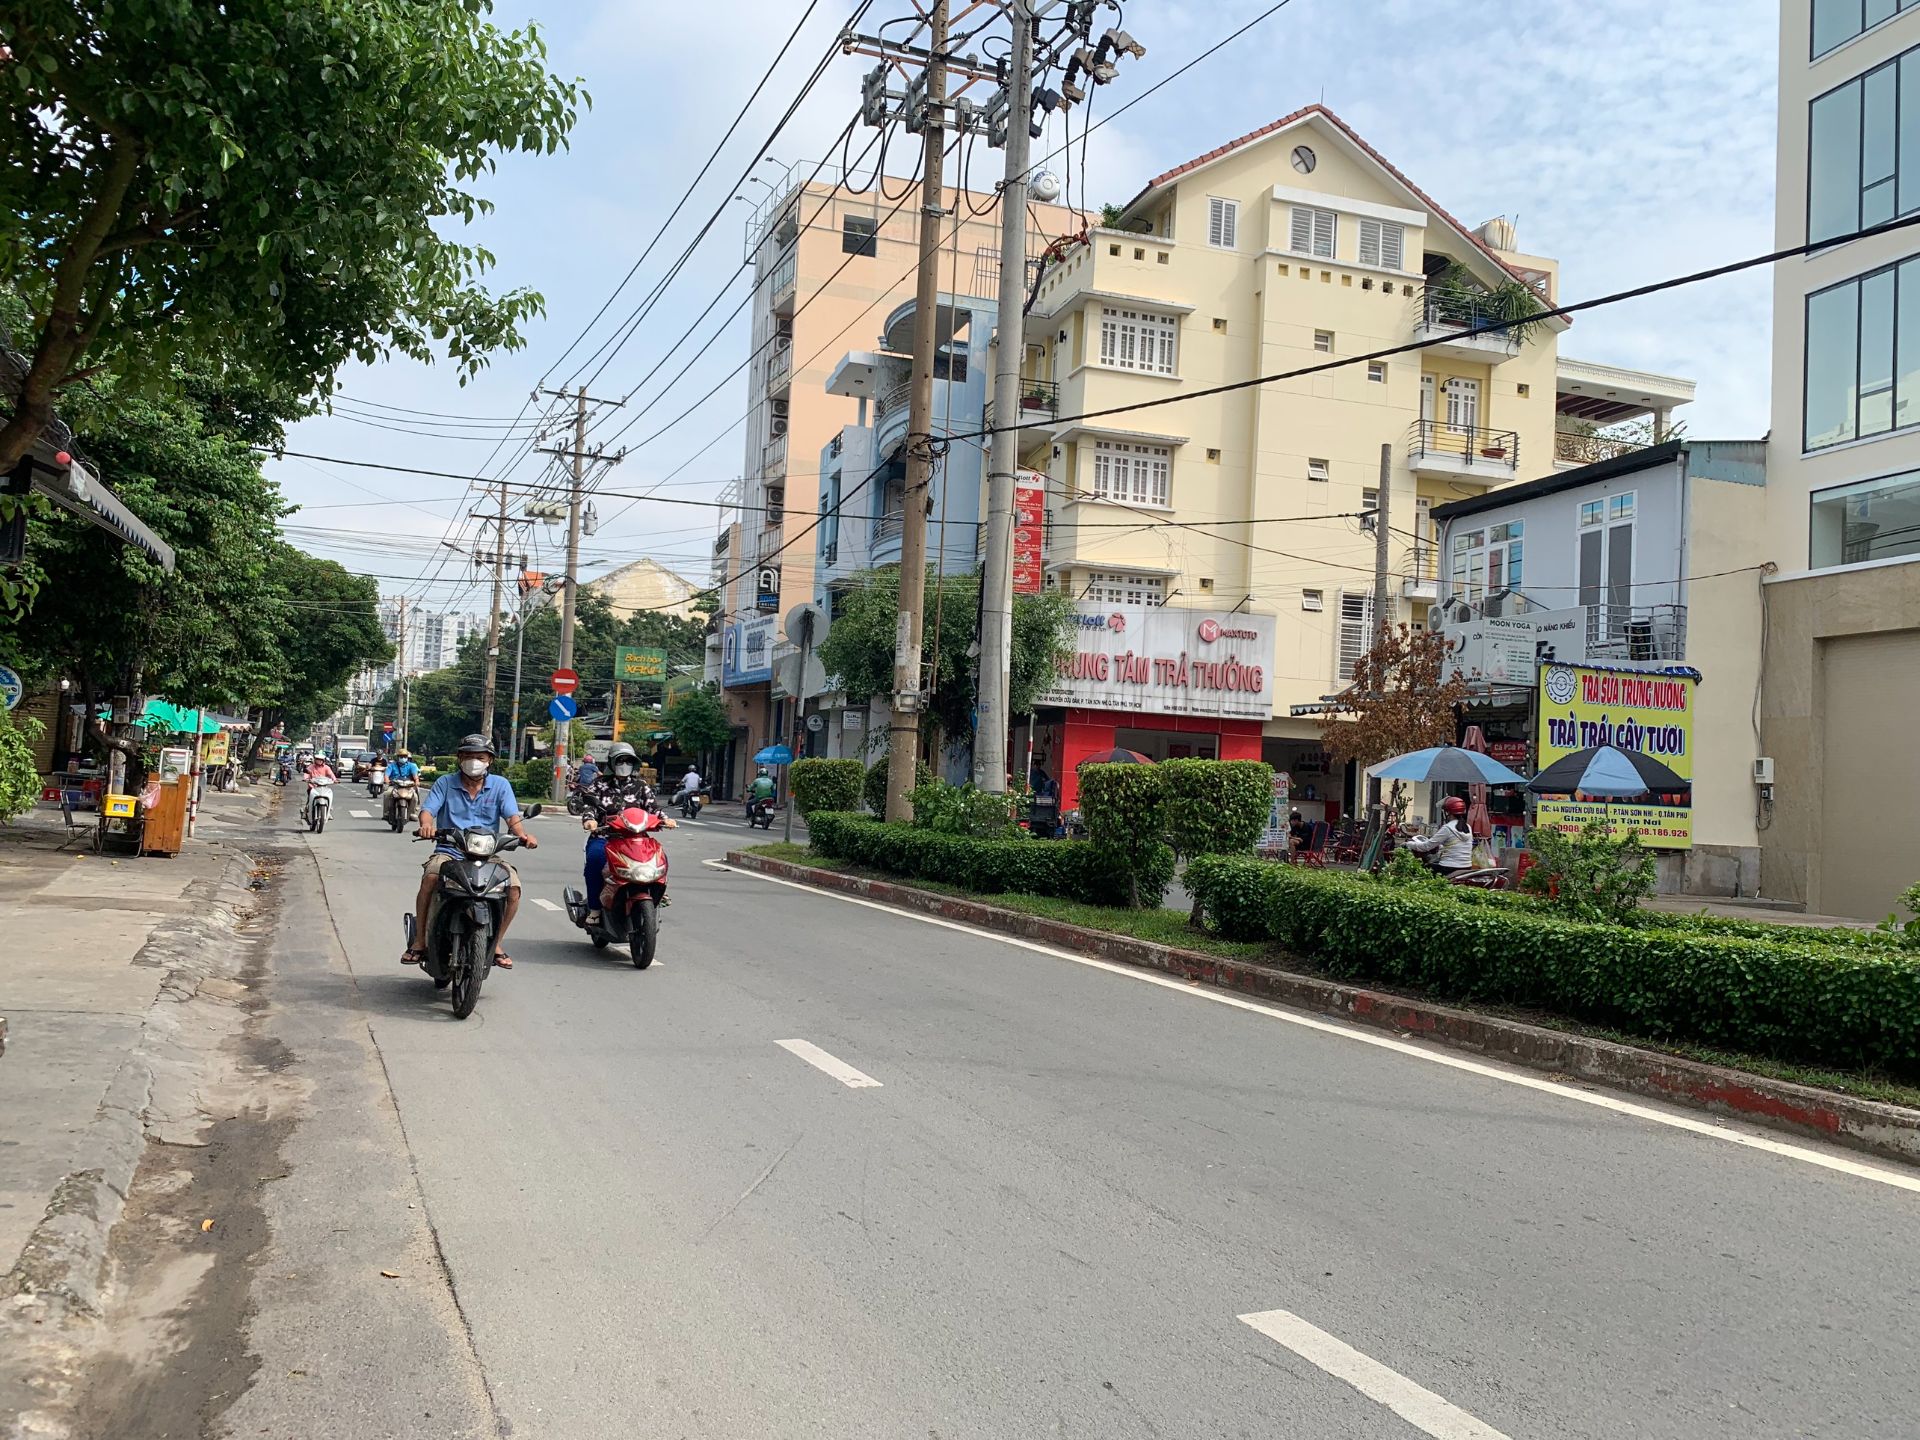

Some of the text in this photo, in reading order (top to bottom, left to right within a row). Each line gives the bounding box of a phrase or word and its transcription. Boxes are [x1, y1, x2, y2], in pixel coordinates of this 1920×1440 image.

[1489, 619, 1531, 630] MOON YOGA
[1114, 650, 1150, 684] TÂM
[1154, 651, 1189, 687] TRẢ
[1193, 654, 1263, 693] THƯỞNG
[1582, 669, 1687, 711] TRÀ SỮA TRỨNG NƯỚNG
[1548, 710, 1685, 755] TRÀ TRÁI CÂY TƯƠI
[1563, 815, 1587, 823] Giao
